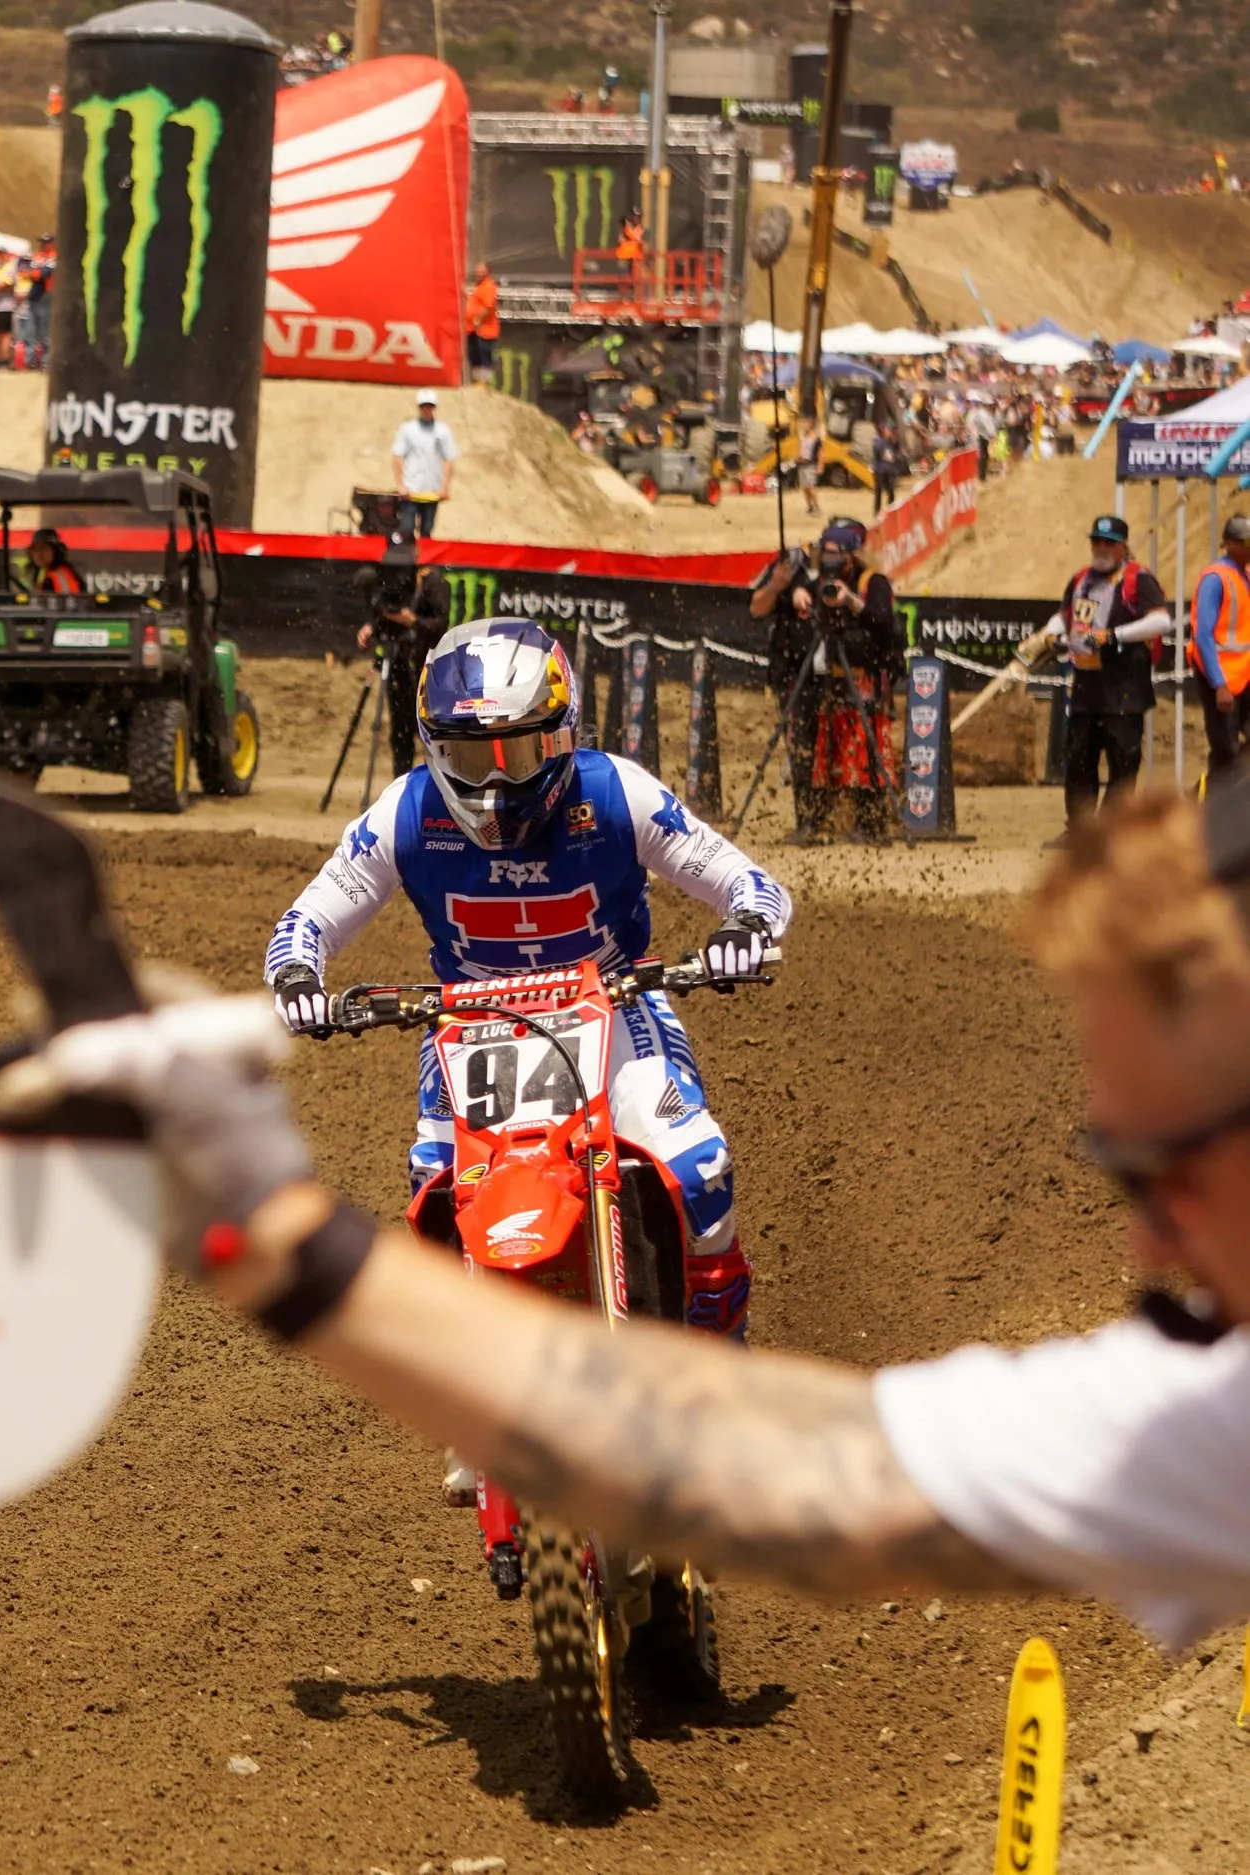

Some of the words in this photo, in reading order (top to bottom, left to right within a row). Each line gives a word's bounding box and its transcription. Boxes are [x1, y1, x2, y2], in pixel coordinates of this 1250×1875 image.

[424, 840, 466, 852] SHOWA
[451, 968, 583, 995] RENTHAL
[466, 1036, 581, 1132] 94
[486, 1232, 546, 1246] HONDA
